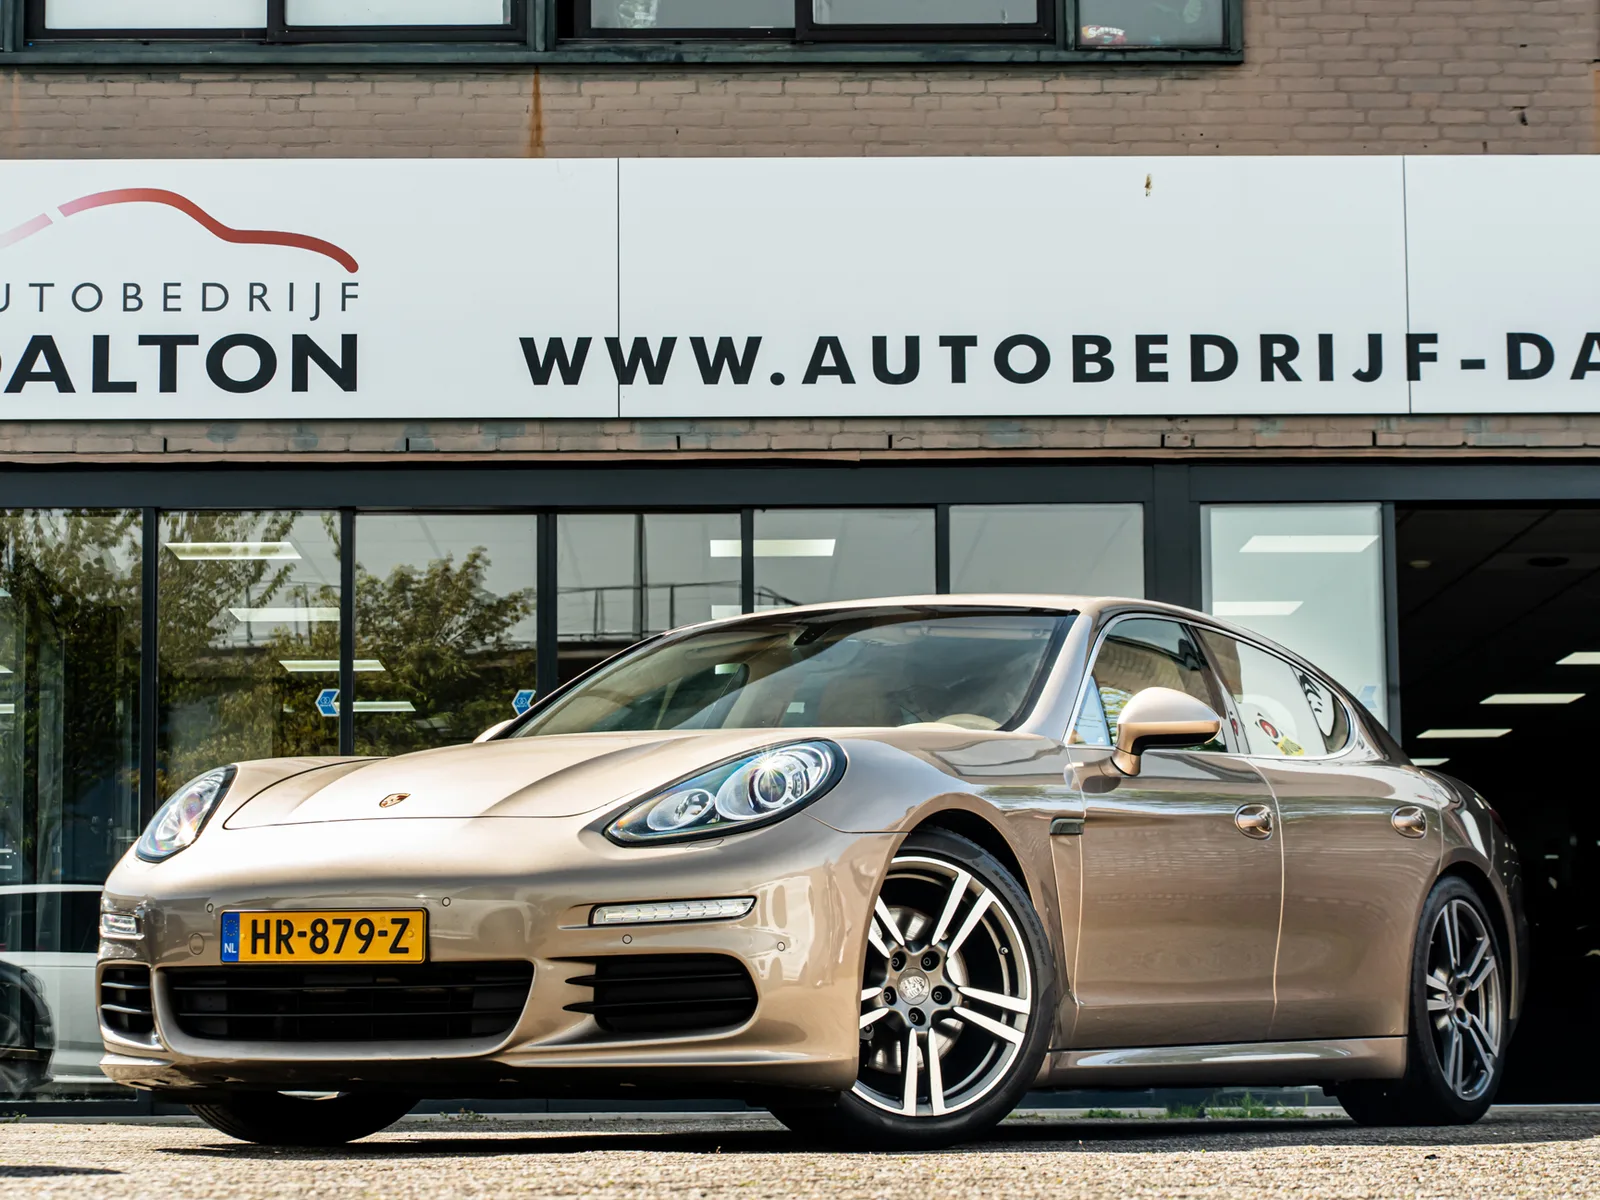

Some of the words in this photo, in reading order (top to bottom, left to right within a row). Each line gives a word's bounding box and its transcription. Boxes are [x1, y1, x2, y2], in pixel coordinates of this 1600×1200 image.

[0, 333, 358, 393] ALTON
[518, 331, 1600, 386] WWW.AUTOBEDRIJF-DA
[224, 942, 237, 954] NL
[251, 917, 410, 955] HR-879-Z
